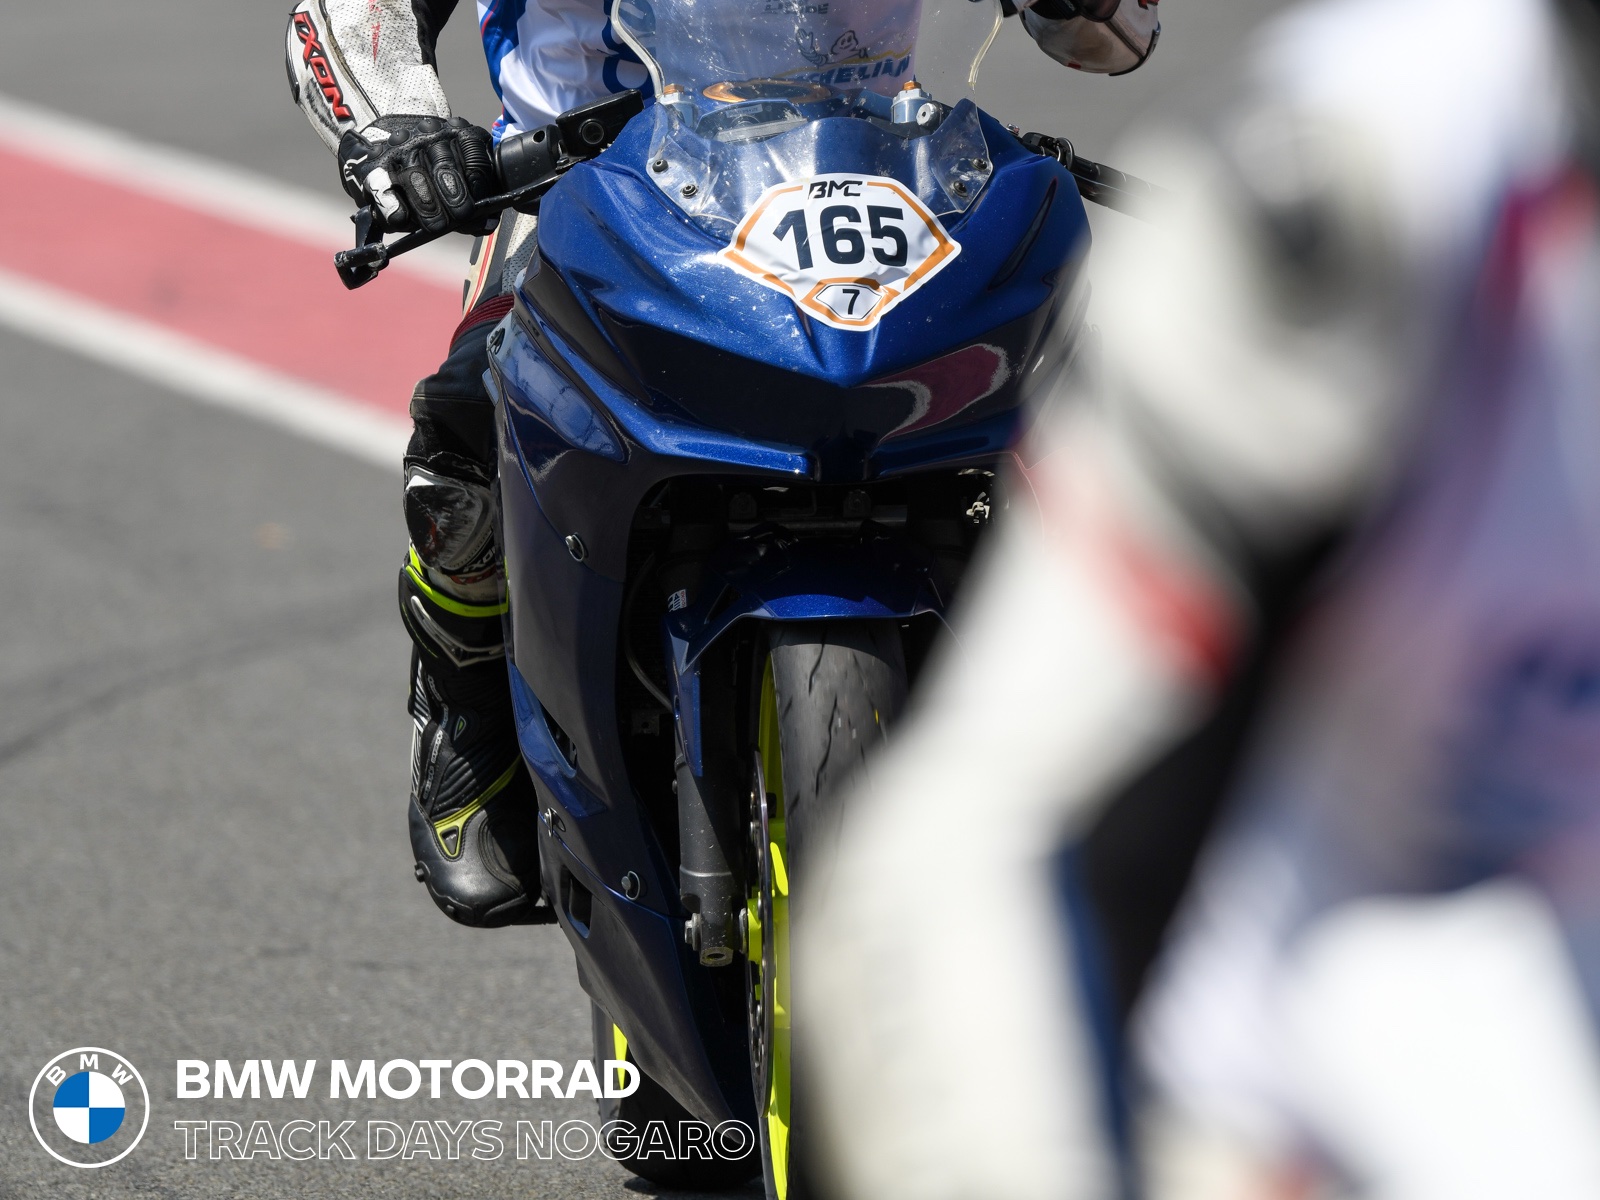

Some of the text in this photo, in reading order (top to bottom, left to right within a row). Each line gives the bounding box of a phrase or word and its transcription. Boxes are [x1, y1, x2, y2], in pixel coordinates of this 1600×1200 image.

[292, 11, 355, 120] IXON
[807, 180, 862, 199] BMC
[772, 205, 908, 270] 165
[842, 289, 860, 315] 7
